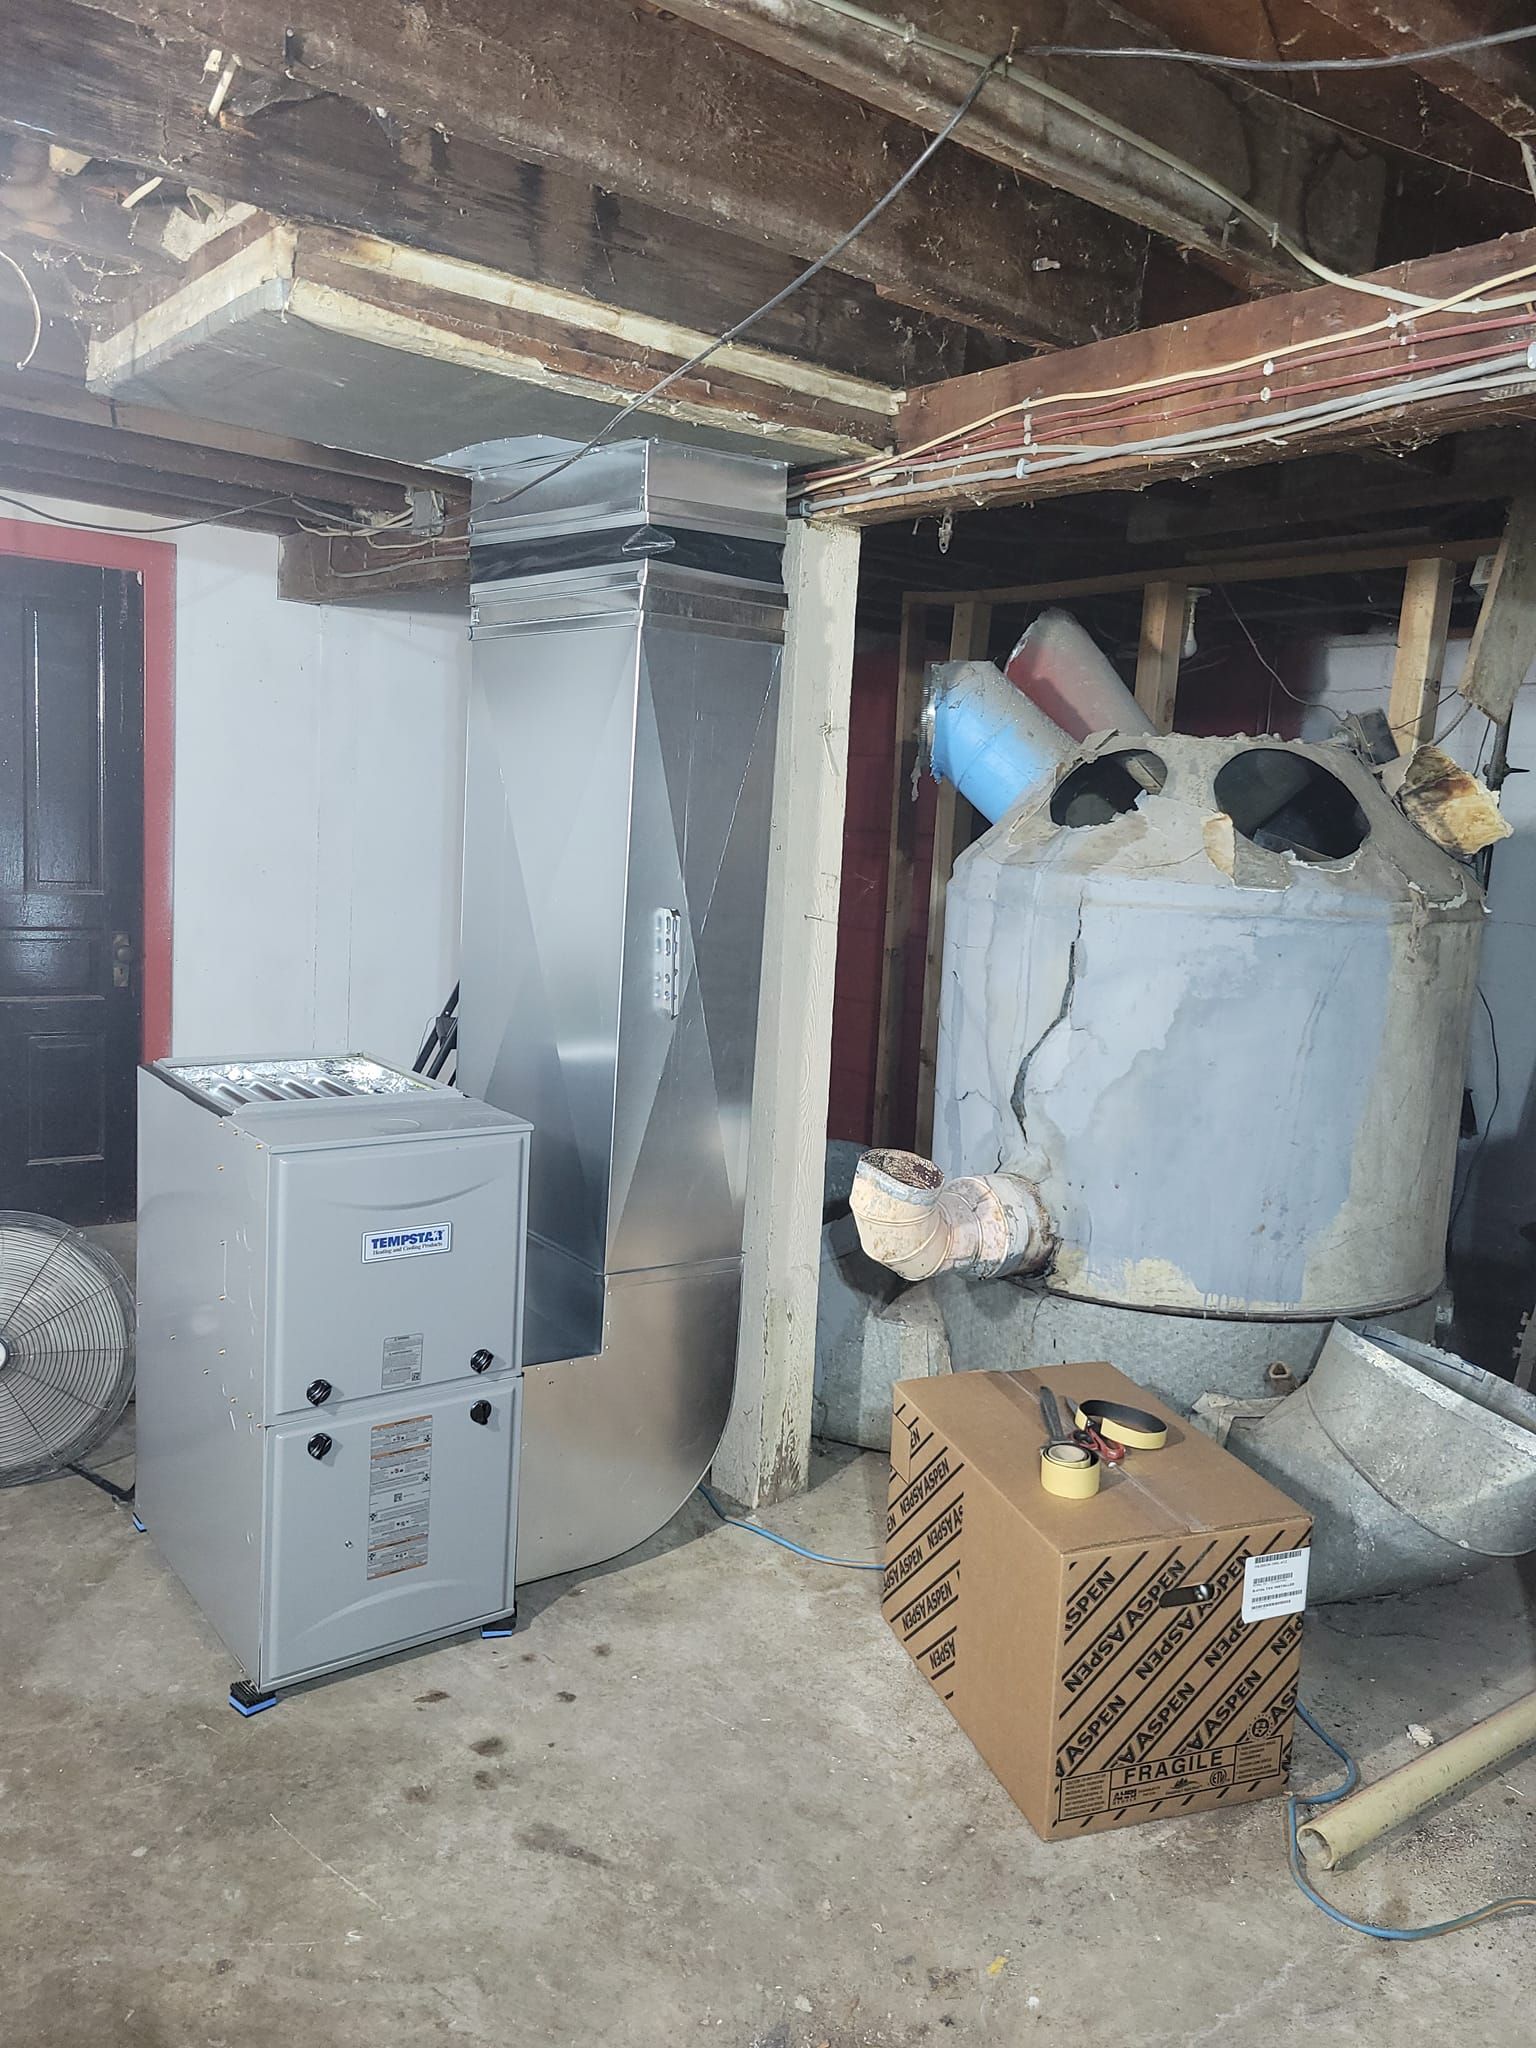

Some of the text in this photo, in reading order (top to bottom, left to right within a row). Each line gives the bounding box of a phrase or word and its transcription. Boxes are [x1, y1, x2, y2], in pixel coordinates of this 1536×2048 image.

[924, 1458, 950, 1496] ASPEN
[900, 1484, 924, 1517] ASPEN
[927, 1513, 953, 1550] ASPEN
[899, 1545, 923, 1579] ASPEN
[927, 1580, 952, 1614] ASPEN
[1125, 1560, 1186, 1631] ASPEN
[901, 1599, 926, 1631] ASPEN
[1064, 1623, 1125, 1693] ASPEN
[1135, 1610, 1195, 1680] ASPEN
[1136, 1682, 1196, 1752] ASPEN
[1204, 1669, 1262, 1738] ASPEN
[1066, 1694, 1126, 1764] ASPEN
[1124, 1750, 1223, 1784] FRAGILE
